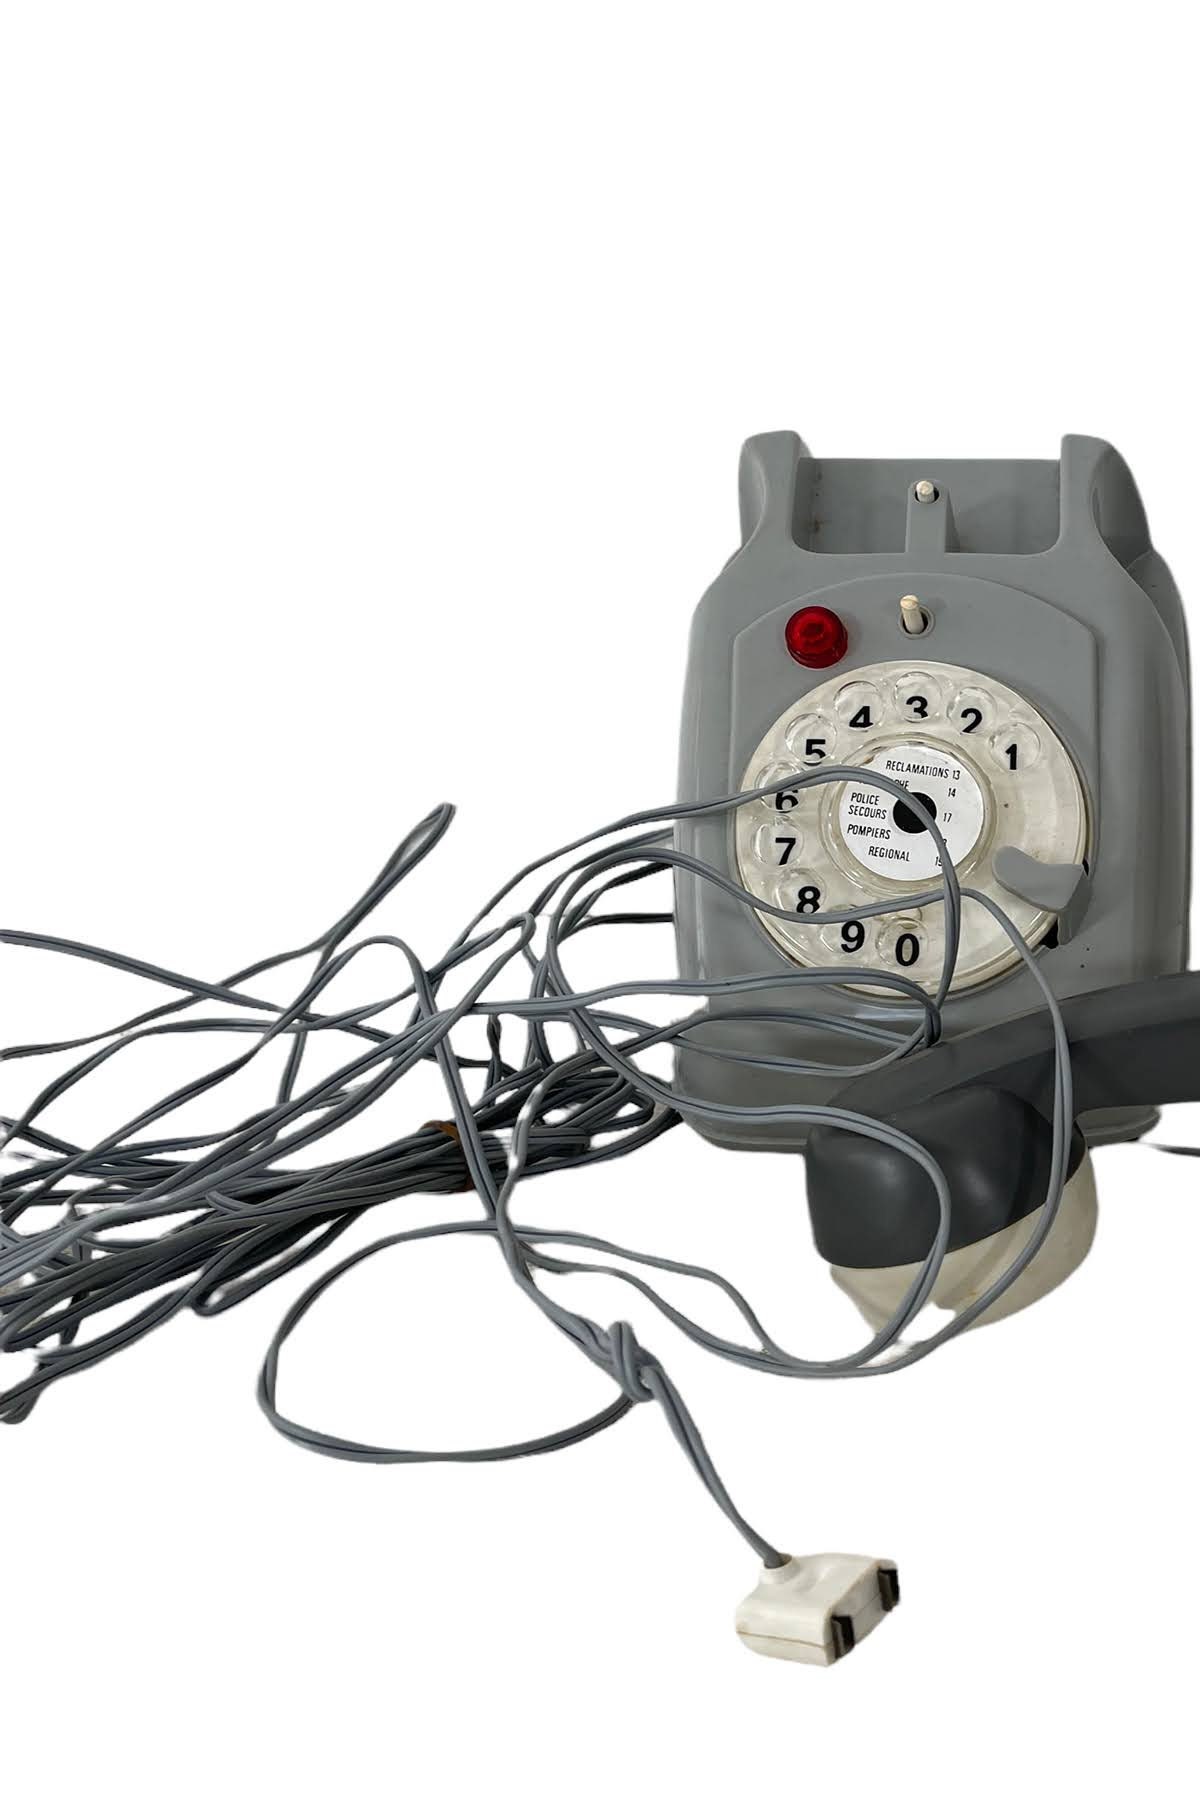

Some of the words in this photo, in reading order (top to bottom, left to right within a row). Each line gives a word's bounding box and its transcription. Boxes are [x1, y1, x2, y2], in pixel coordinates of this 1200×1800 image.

[849, 706, 874, 731] 4
[906, 696, 928, 720] 3
[961, 708, 983, 734] 2
[804, 739, 826, 766] 5
[1005, 743, 1018, 770] 1
[885, 760, 949, 779] RECLAMATIONS
[952, 770, 961, 780] 13
[775, 789, 799, 813] 6
[850, 792, 880, 806] POLICE
[947, 788, 956, 798] 14
[848, 804, 887, 820] SECOURS
[943, 812, 952, 823] 17
[847, 823, 891, 840] POMPIERS
[776, 838, 796, 866] 7
[868, 845, 910, 862] REGIONAL
[796, 886, 821, 914] 8
[840, 919, 866, 953] 9
[894, 932, 920, 967] 0
